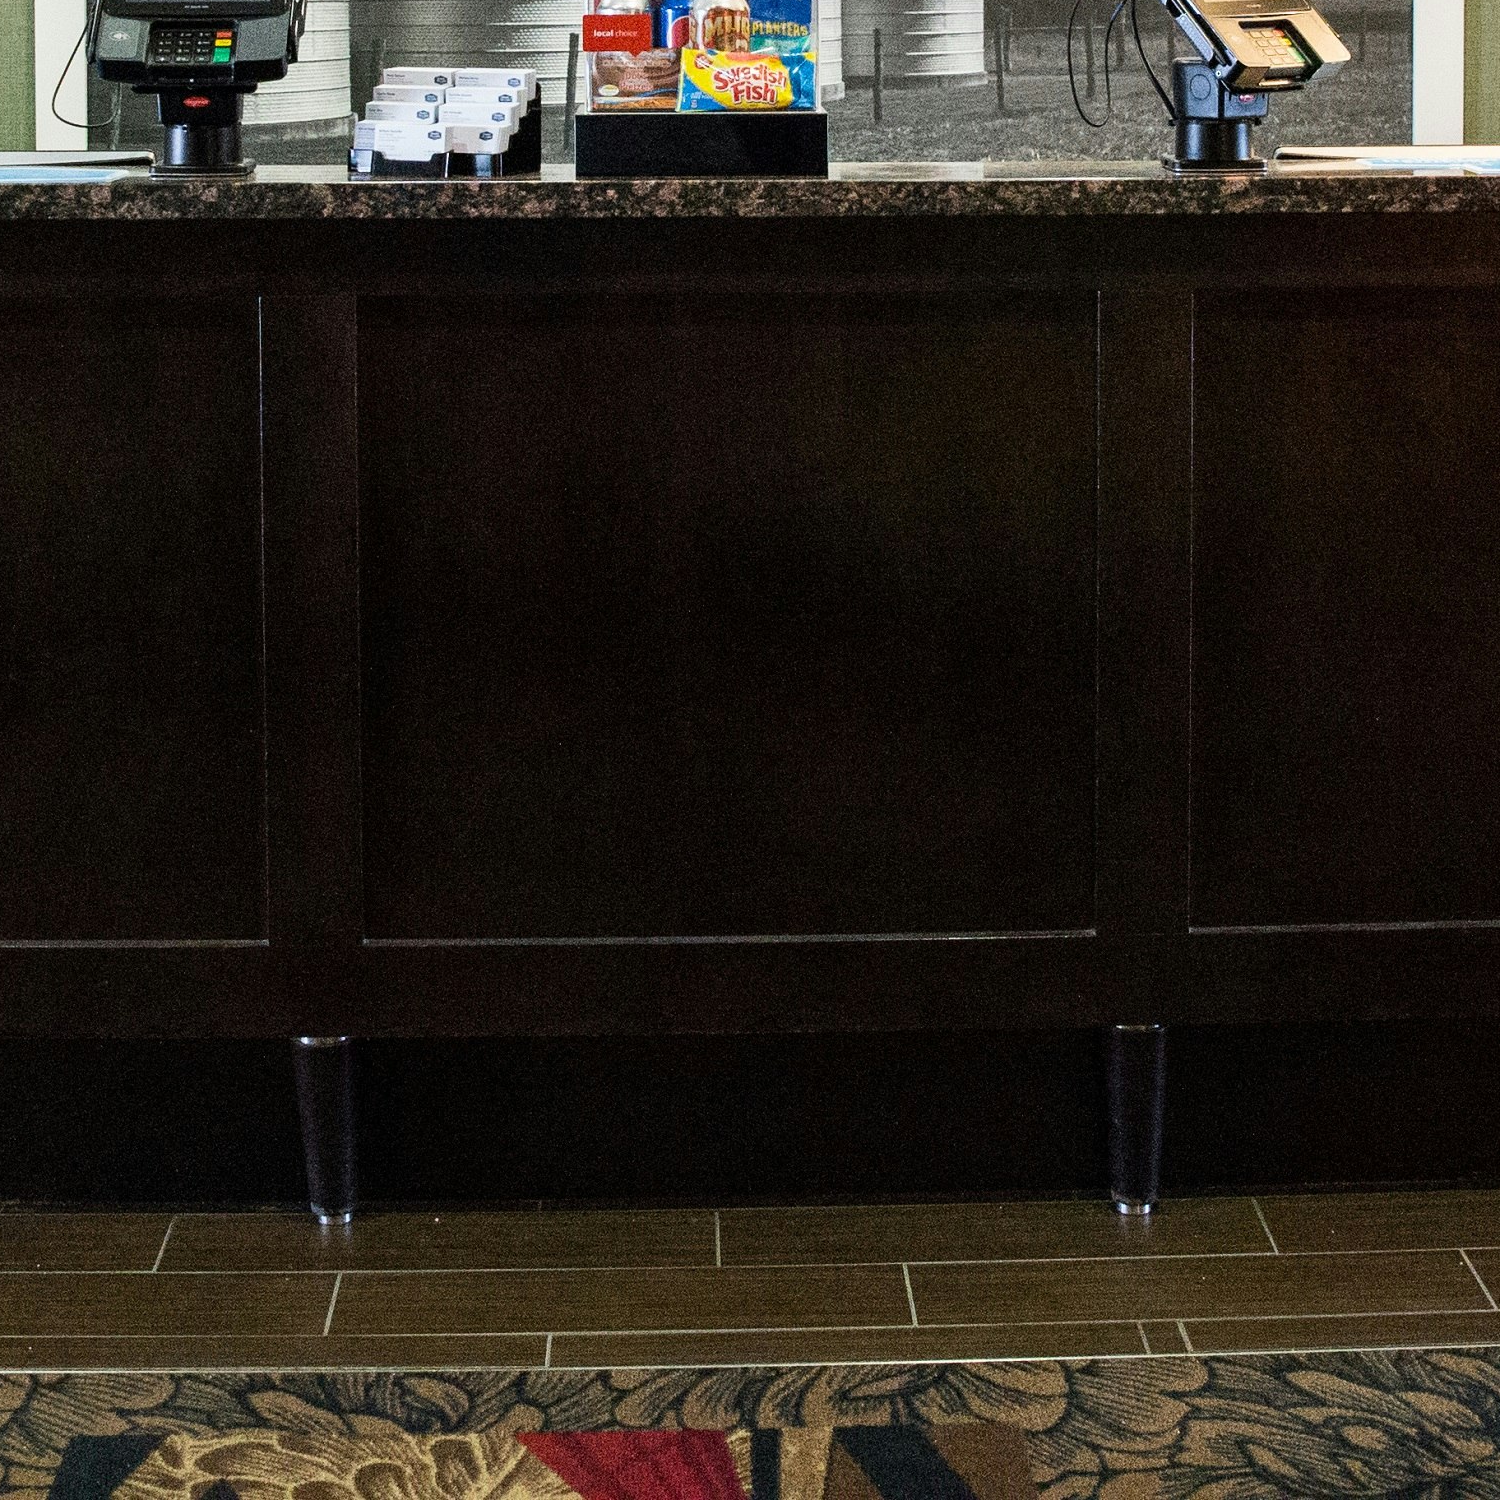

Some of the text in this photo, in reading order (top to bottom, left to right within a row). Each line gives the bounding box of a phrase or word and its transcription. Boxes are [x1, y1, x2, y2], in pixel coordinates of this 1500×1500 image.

[593, 28, 638, 37] local choice
[751, 20, 809, 37] PLANTERS
[712, 64, 787, 91] Swedish
[731, 82, 777, 104] Fish
